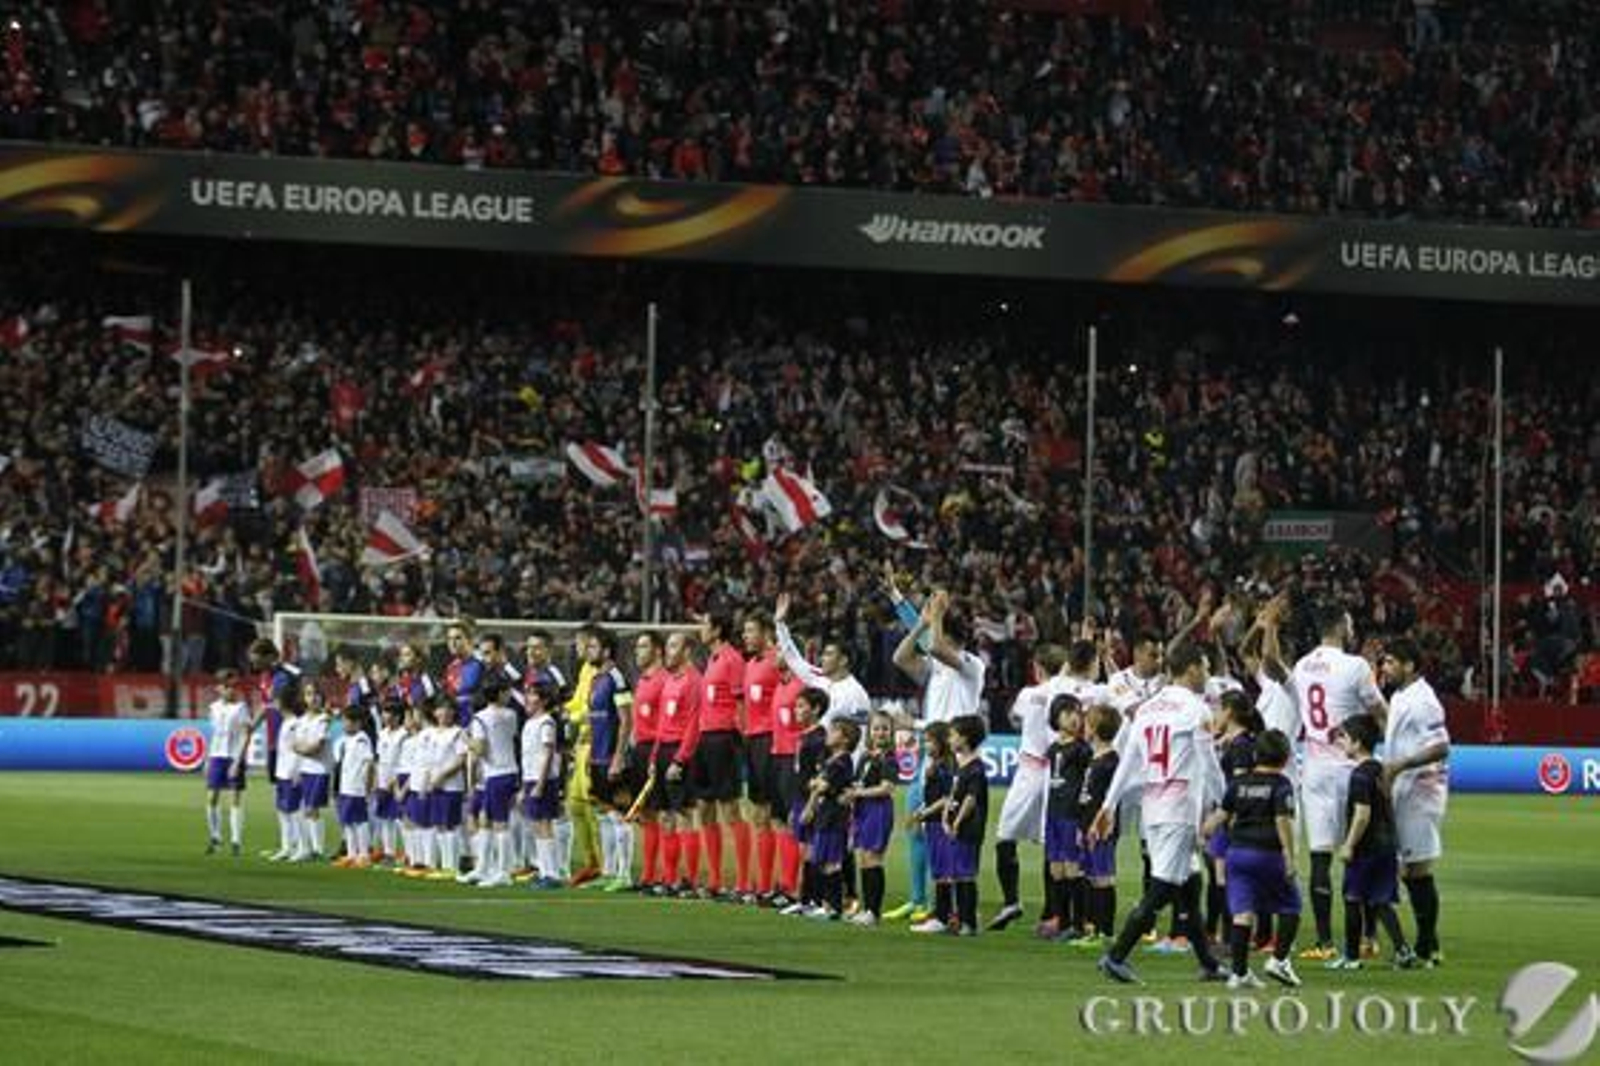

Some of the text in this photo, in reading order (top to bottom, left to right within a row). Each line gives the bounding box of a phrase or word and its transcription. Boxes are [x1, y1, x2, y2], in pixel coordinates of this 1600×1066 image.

[191, 179, 533, 224] UEFA EUROPA LEAGUE
[1341, 242, 1600, 279] UEFA EUROPA LEAG
[1307, 683, 1329, 730] 8
[981, 746, 1020, 779] SP
[1144, 724, 1171, 777] 14
[1583, 758, 1600, 789] R
